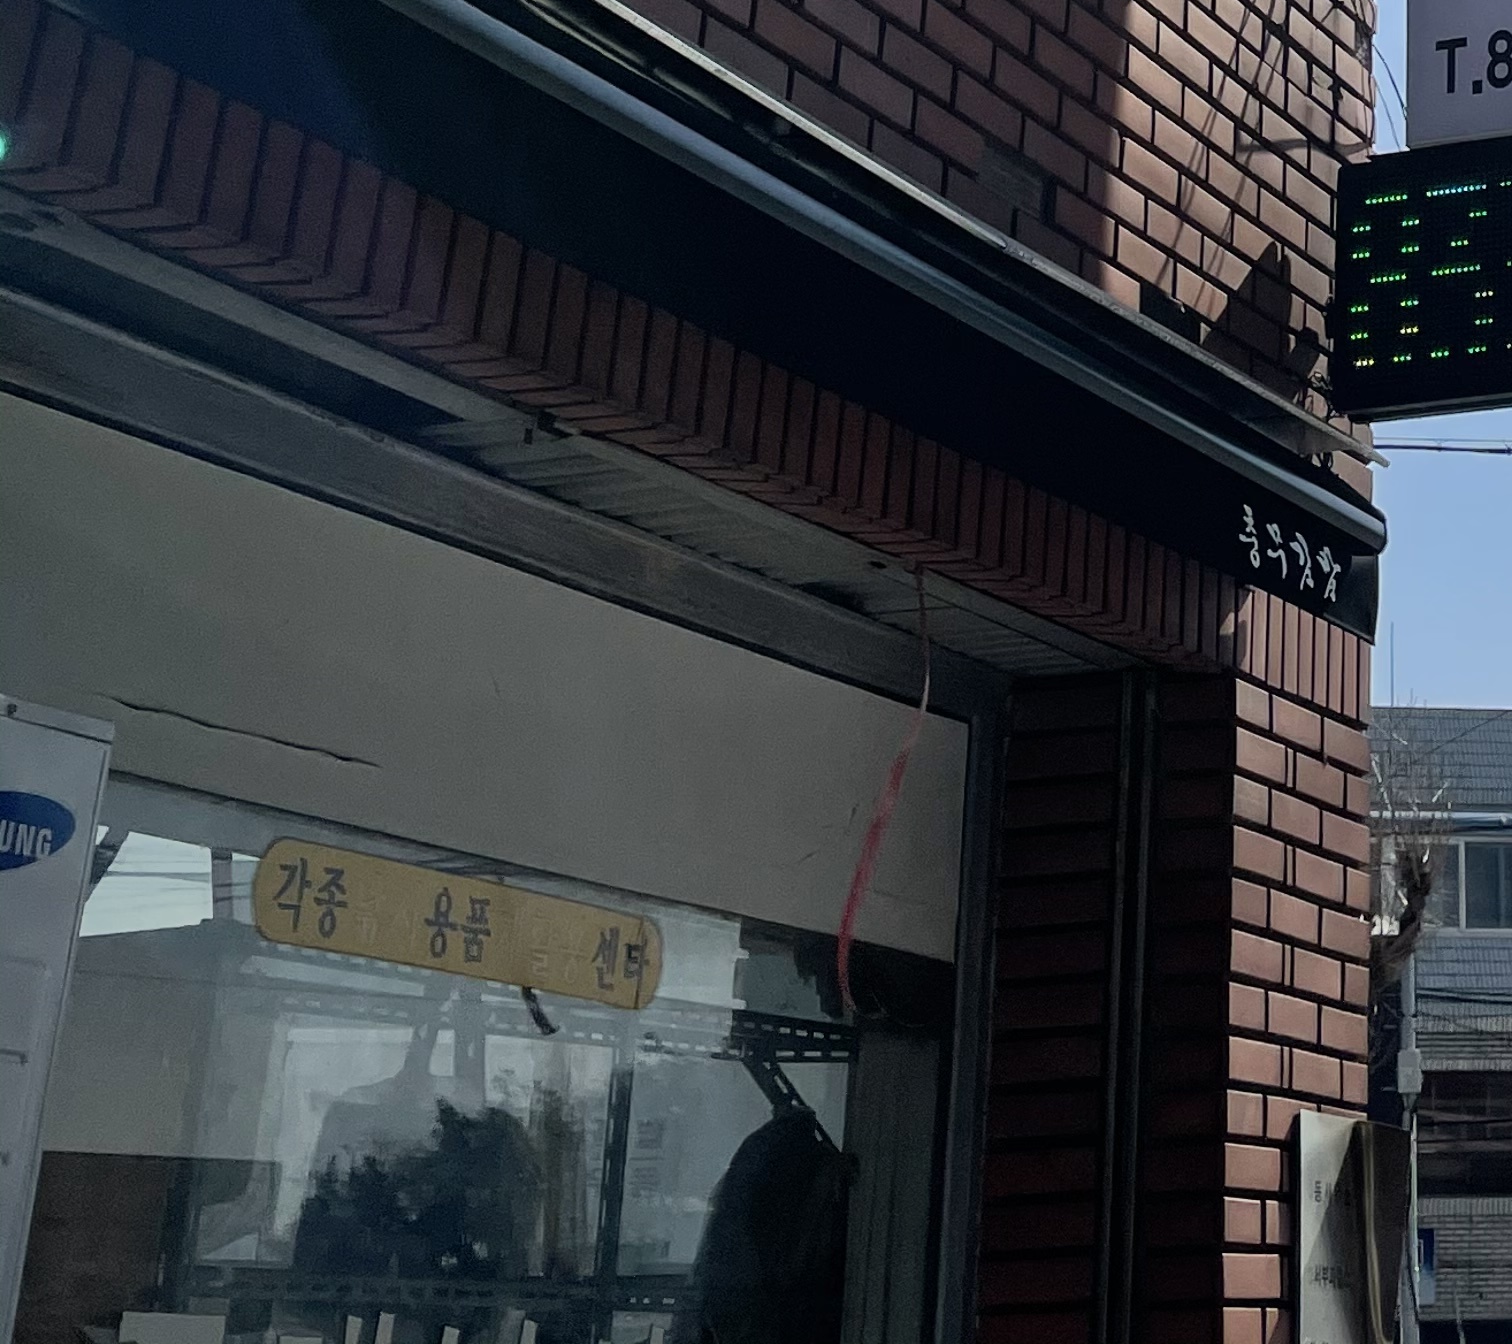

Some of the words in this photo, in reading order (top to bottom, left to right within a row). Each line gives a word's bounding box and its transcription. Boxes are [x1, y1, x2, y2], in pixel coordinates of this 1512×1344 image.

[1239, 504, 1341, 602] 충무김밥
[273, 857, 348, 939] 각종
[424, 886, 492, 964] 용품
